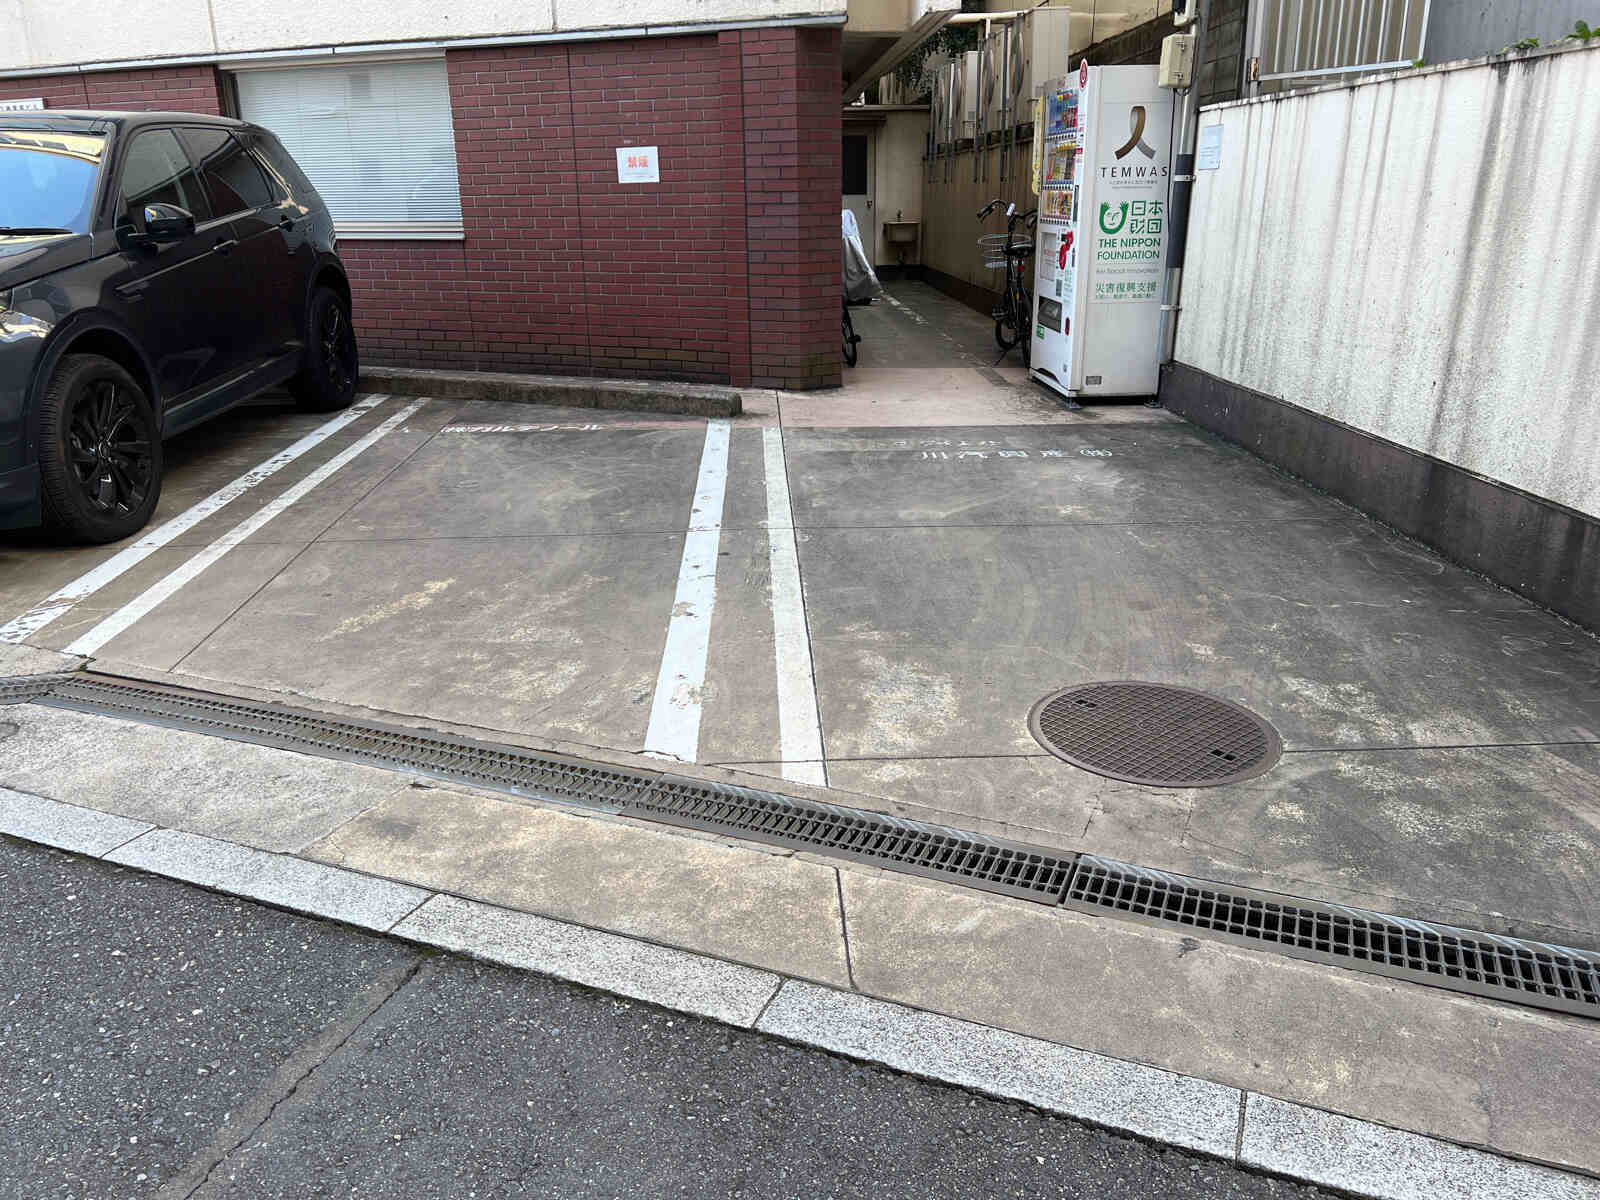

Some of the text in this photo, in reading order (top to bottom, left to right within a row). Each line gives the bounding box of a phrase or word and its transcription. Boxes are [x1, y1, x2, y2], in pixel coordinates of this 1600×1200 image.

[1100, 165, 1168, 178] TEMWAS
[1131, 200, 1163, 216] 日本
[1129, 218, 1162, 234] 財団
[1098, 237, 1161, 248] THE NIPPON
[1097, 250, 1160, 261] FOUNDATION
